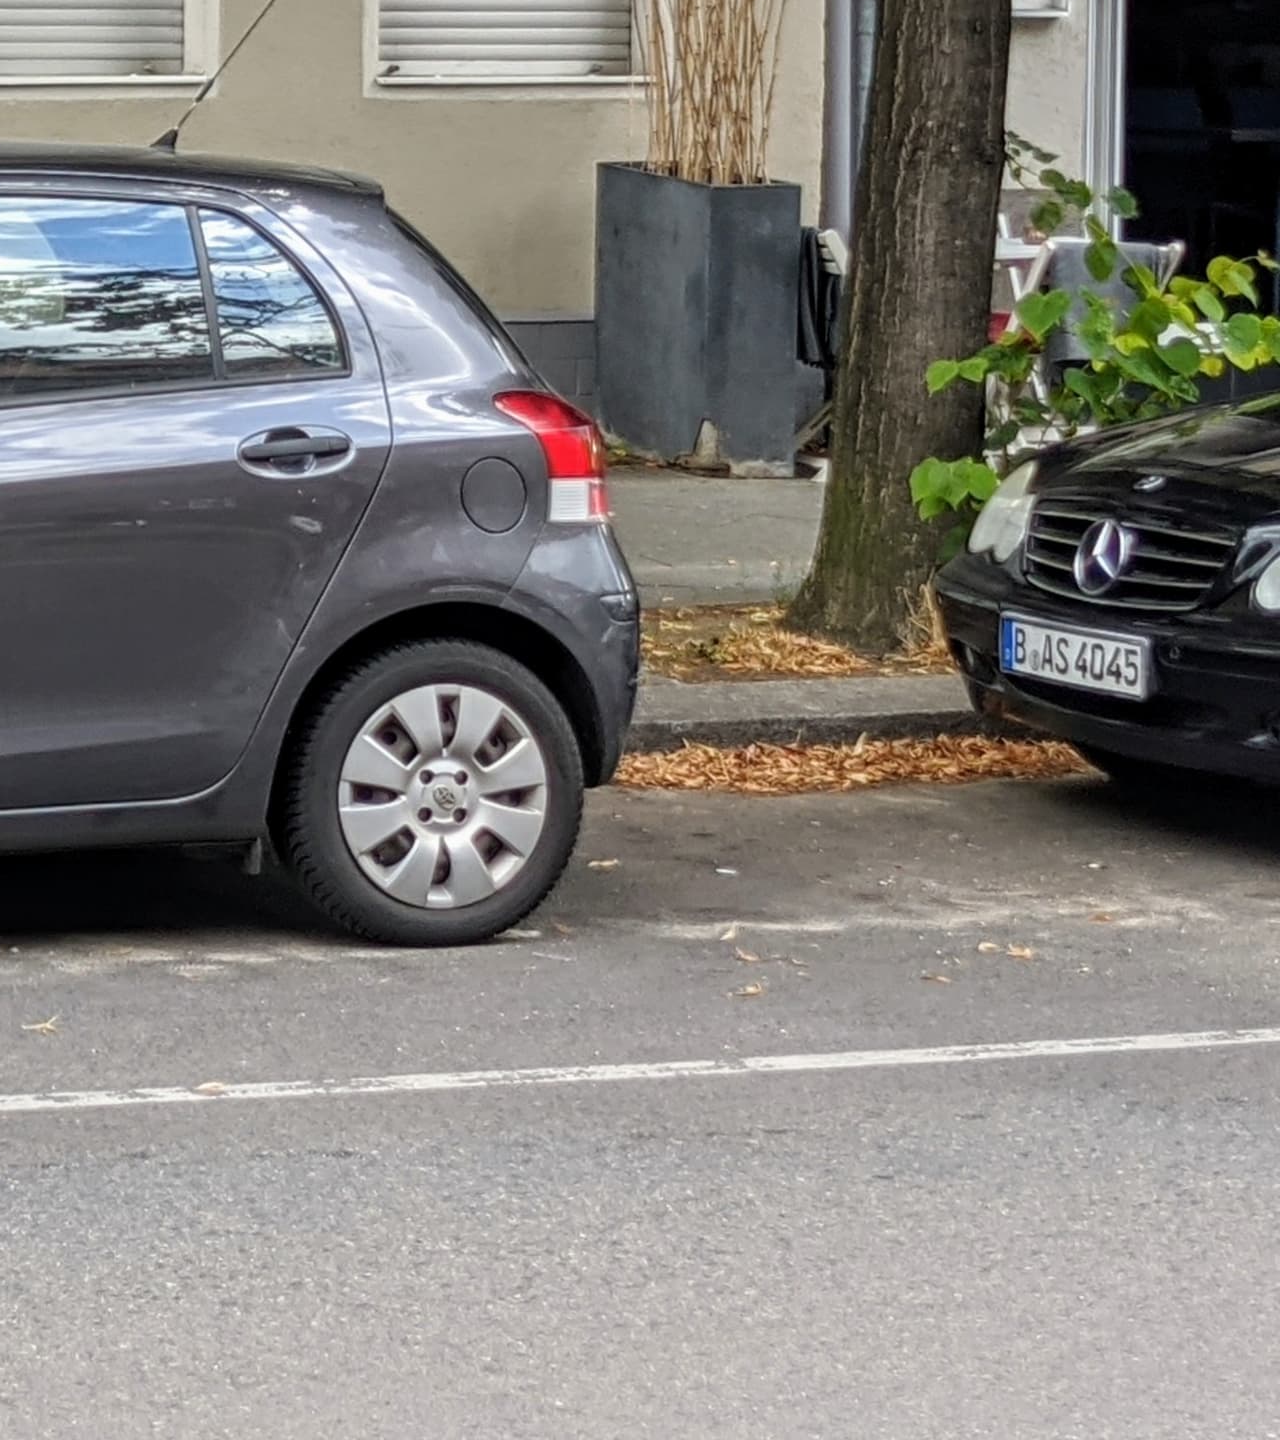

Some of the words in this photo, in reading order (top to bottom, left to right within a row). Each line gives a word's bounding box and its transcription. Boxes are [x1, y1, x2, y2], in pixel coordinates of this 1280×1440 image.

[1014, 627, 1027, 665] B
[1041, 634, 1070, 675] AS
[1074, 641, 1139, 687] 4045
